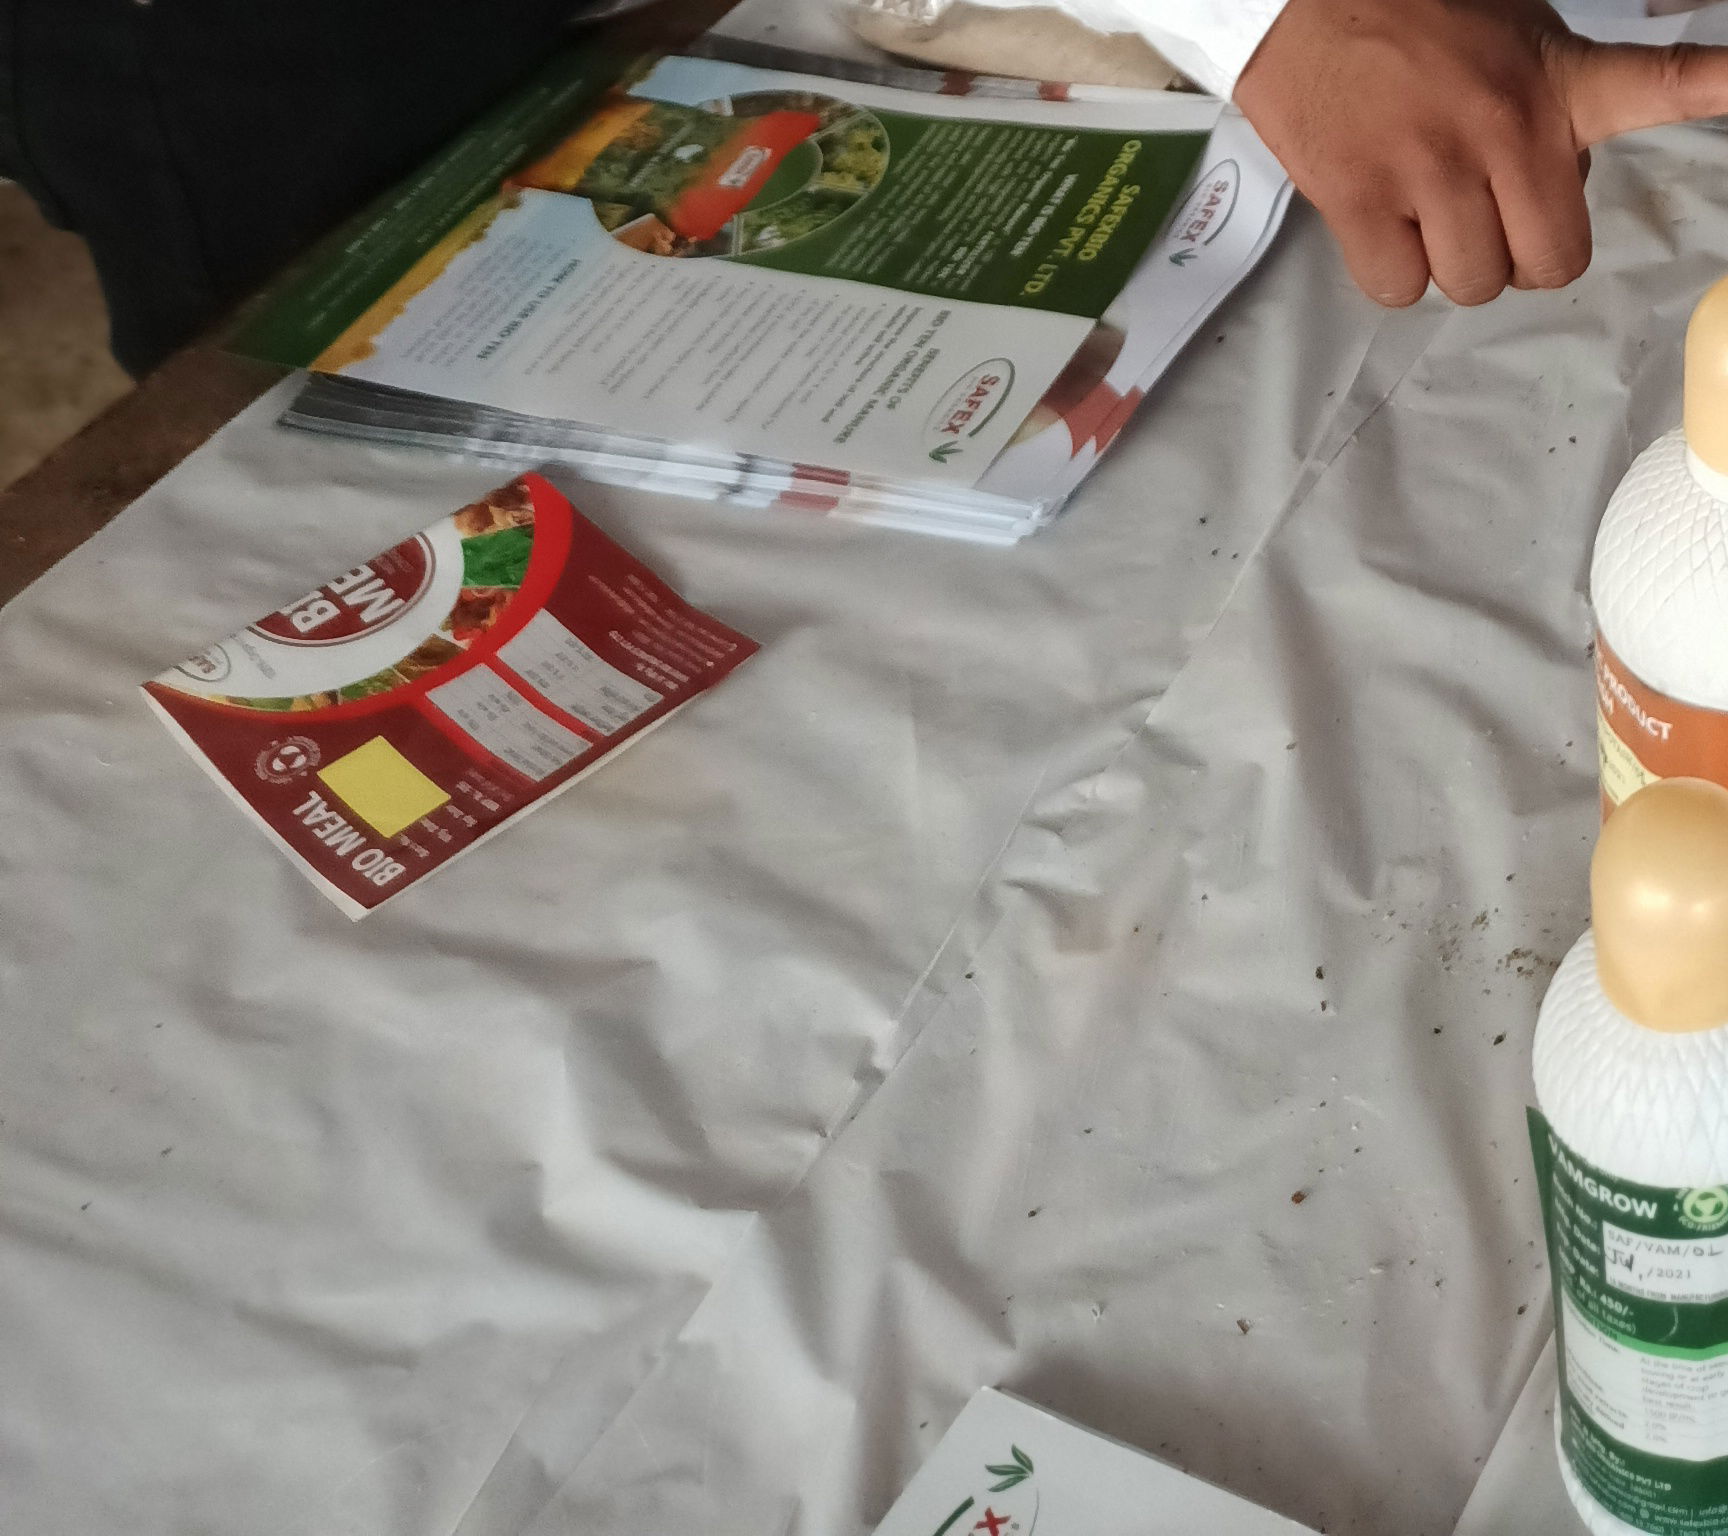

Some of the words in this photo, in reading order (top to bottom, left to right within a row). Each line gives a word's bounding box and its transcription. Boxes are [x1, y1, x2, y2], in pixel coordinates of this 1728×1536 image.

[1076, 140, 1142, 224] ORGANICS
[1180, 180, 1229, 243] SAFEX
[937, 372, 1001, 436] SAFEX
[292, 790, 367, 856] MEAL
[351, 848, 406, 887] BIO
[1548, 1132, 1658, 1220] VAMGROW
